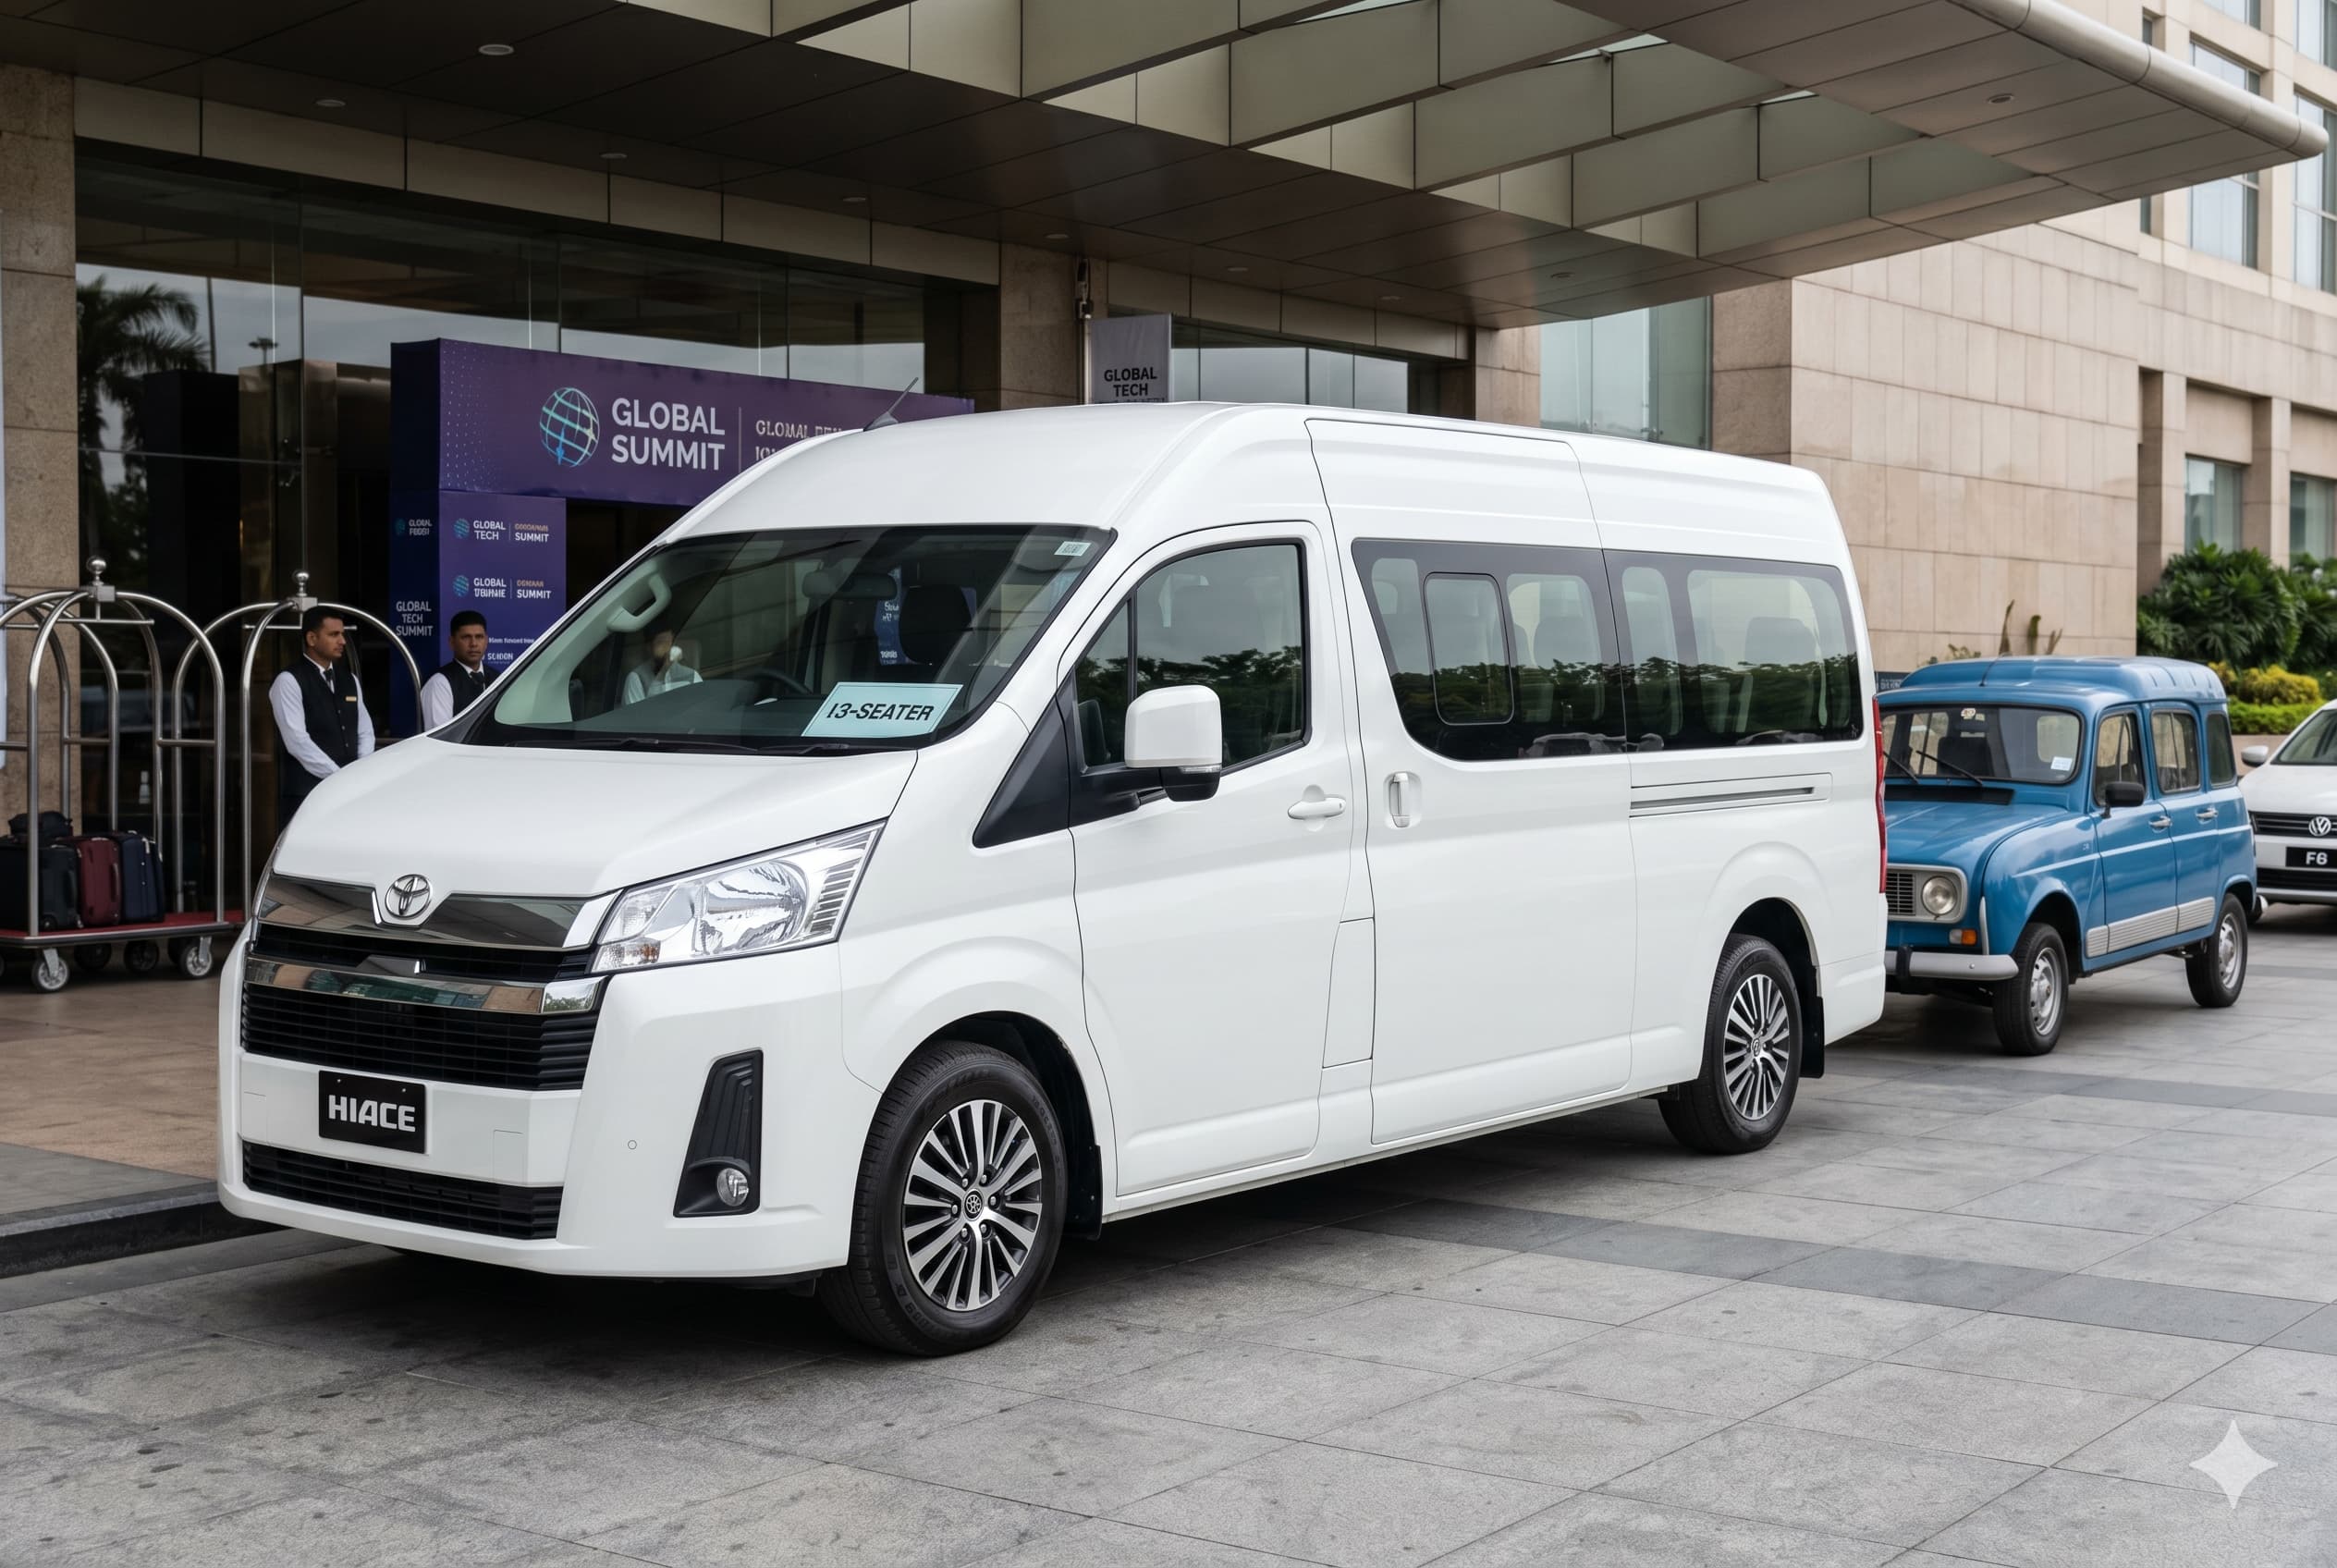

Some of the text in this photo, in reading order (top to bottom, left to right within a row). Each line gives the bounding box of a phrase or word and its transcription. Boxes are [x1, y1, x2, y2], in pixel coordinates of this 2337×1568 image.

[1104, 367, 1157, 382] GLOBAL
[1113, 384, 1148, 397] TECH
[611, 398, 726, 435] GLOBAL
[611, 435, 726, 471] SUMMIT
[472, 521, 506, 531] GLOBAL
[474, 531, 500, 541] TECH
[514, 532, 550, 543] SUMMIT
[473, 577, 507, 588] GLOBAL
[517, 589, 552, 599] SUMMIT
[396, 601, 432, 612] GLOBAL
[402, 614, 423, 624] TECH
[396, 625, 434, 636] SUMMIT
[328, 1094, 416, 1133] HIACE
